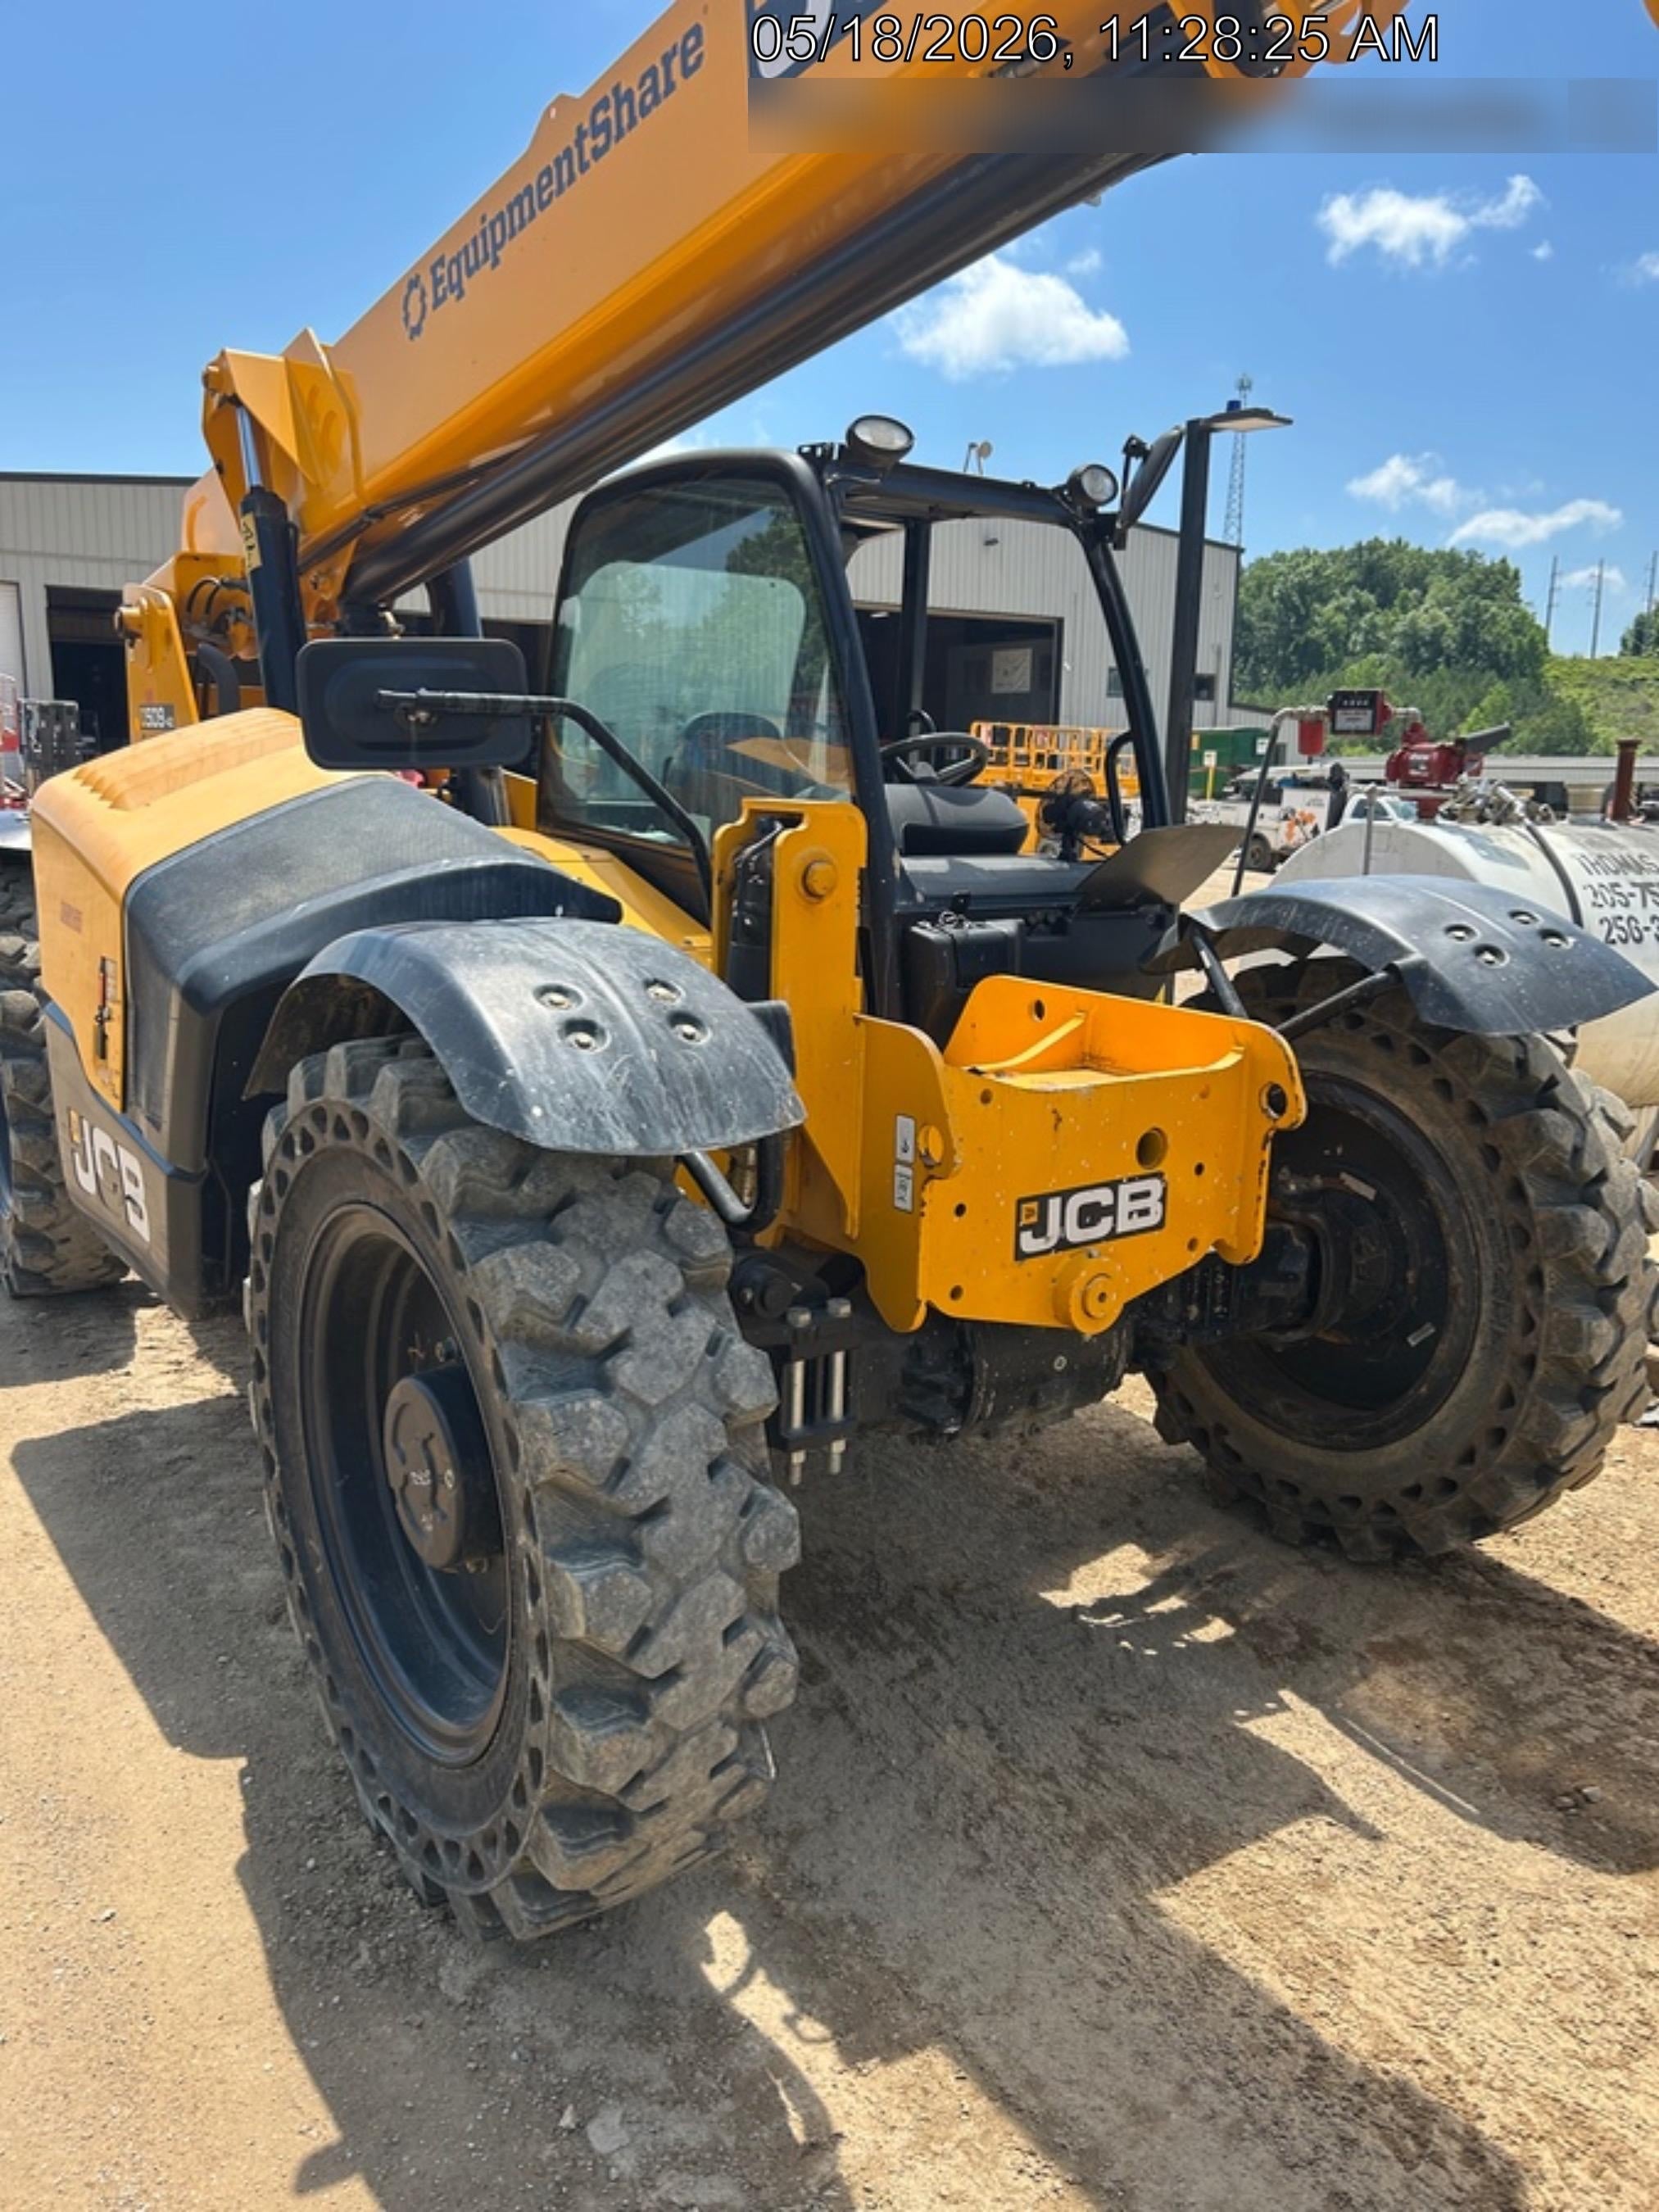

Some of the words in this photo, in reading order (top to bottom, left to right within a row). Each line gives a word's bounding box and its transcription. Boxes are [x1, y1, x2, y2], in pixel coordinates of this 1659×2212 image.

[429, 21, 705, 310] EquipmentShare
[75, 1118, 151, 1243] JCB
[1020, 1178, 1164, 1253] JCB
